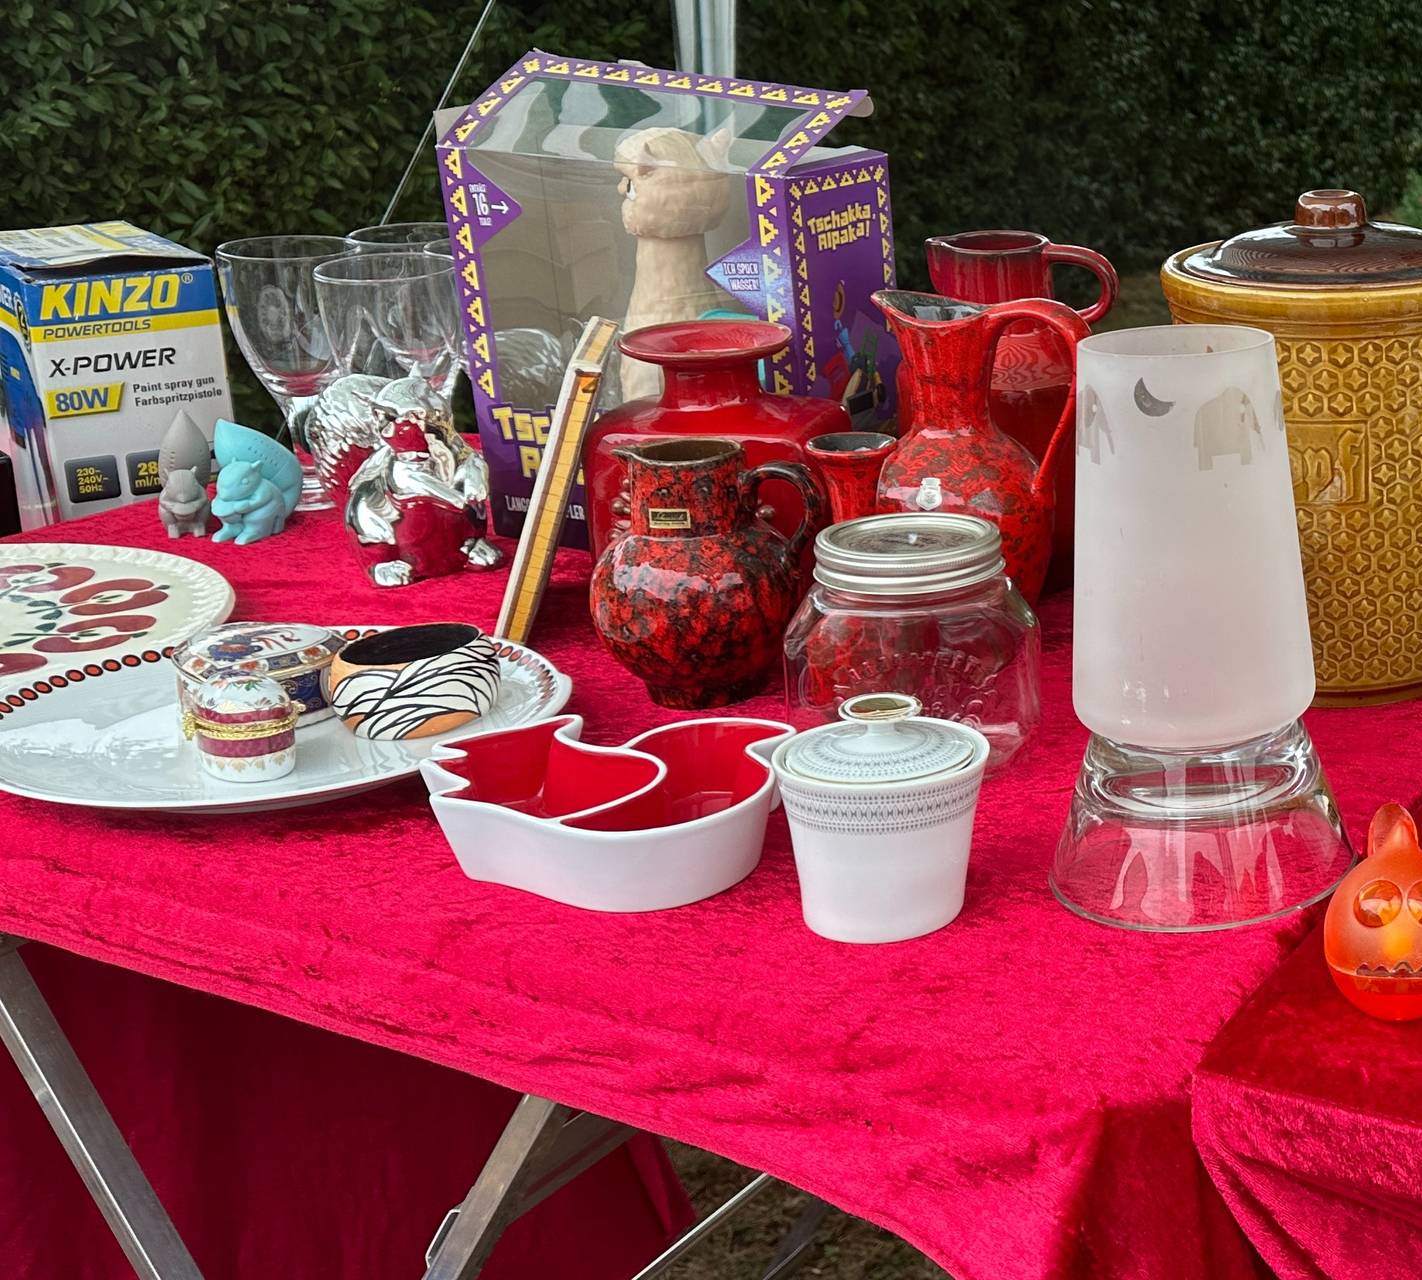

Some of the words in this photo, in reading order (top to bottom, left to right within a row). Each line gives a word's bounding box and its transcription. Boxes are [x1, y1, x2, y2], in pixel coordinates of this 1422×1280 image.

[472, 192, 489, 216] 16
[43, 319, 151, 339] POWERTOOLS
[49, 347, 176, 378] X-POWER
[133, 382, 161, 393] Paint
[164, 379, 193, 391] spray
[196, 376, 215, 388] gun
[55, 387, 109, 412] 80W
[135, 387, 222, 406] Farbspritzpistole
[79, 484, 103, 494] 50Hz
